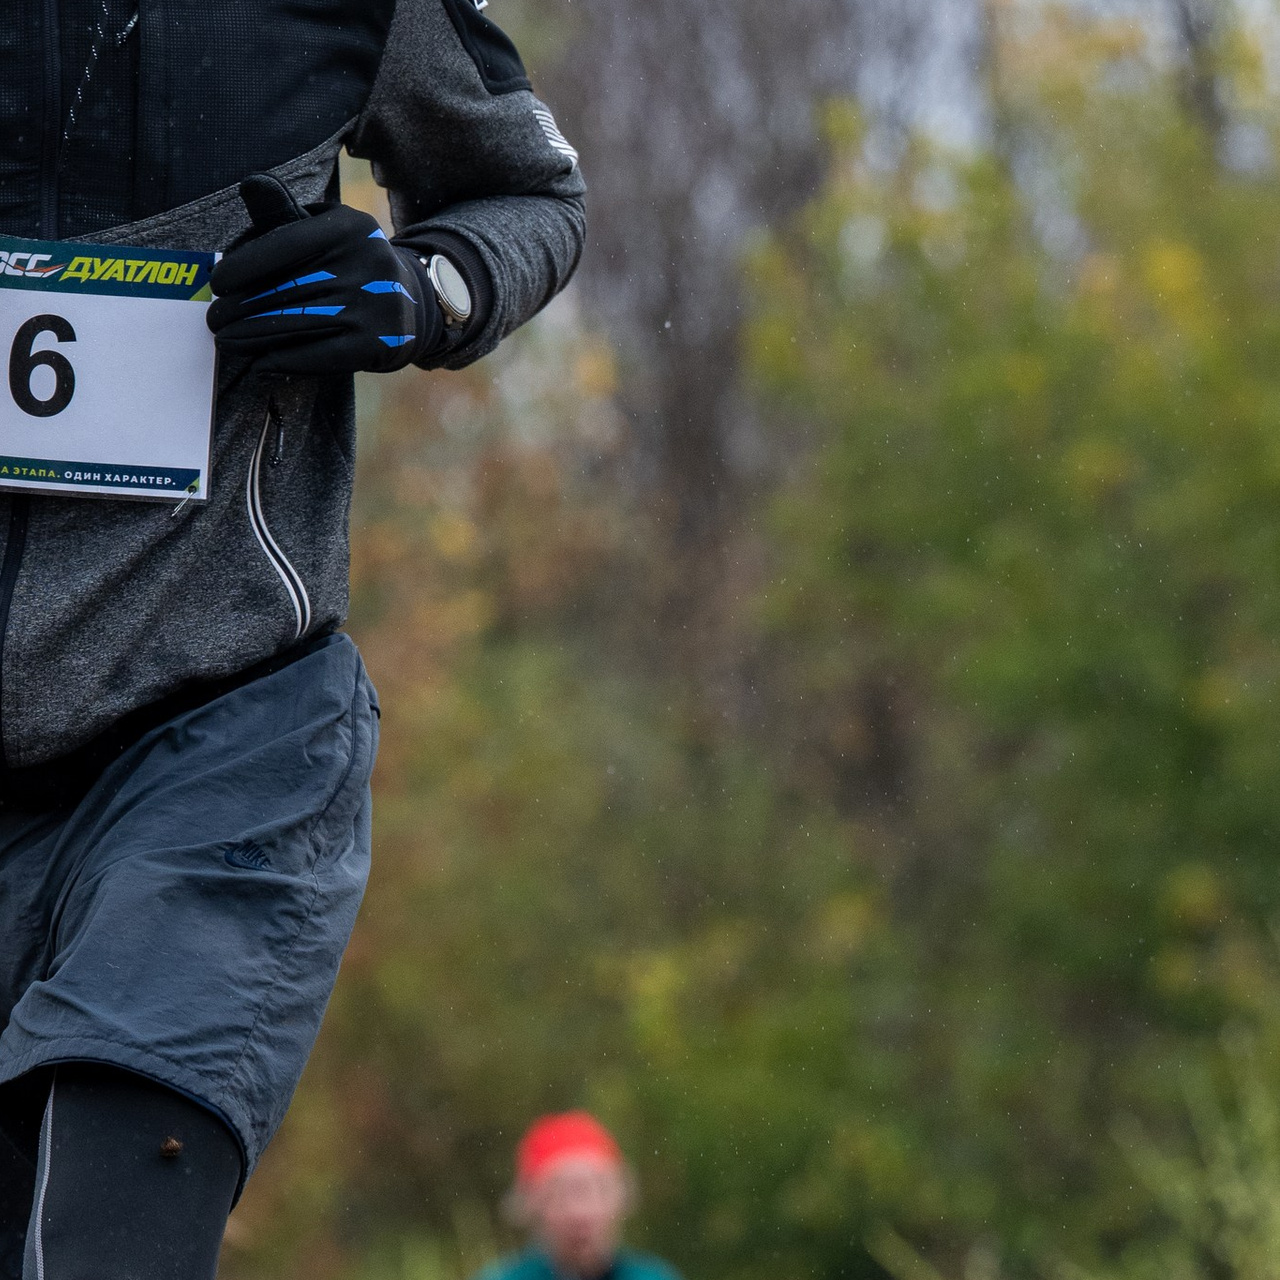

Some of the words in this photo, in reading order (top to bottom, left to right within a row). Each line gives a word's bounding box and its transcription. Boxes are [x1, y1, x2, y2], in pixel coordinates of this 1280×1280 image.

[58, 256, 200, 286] ДУАТЛОН
[8, 313, 77, 417] 6
[13, 466, 61, 478] ЭТАПА.
[64, 471, 101, 481] ОДИН
[104, 473, 176, 486] ХАРАКТЕР.
